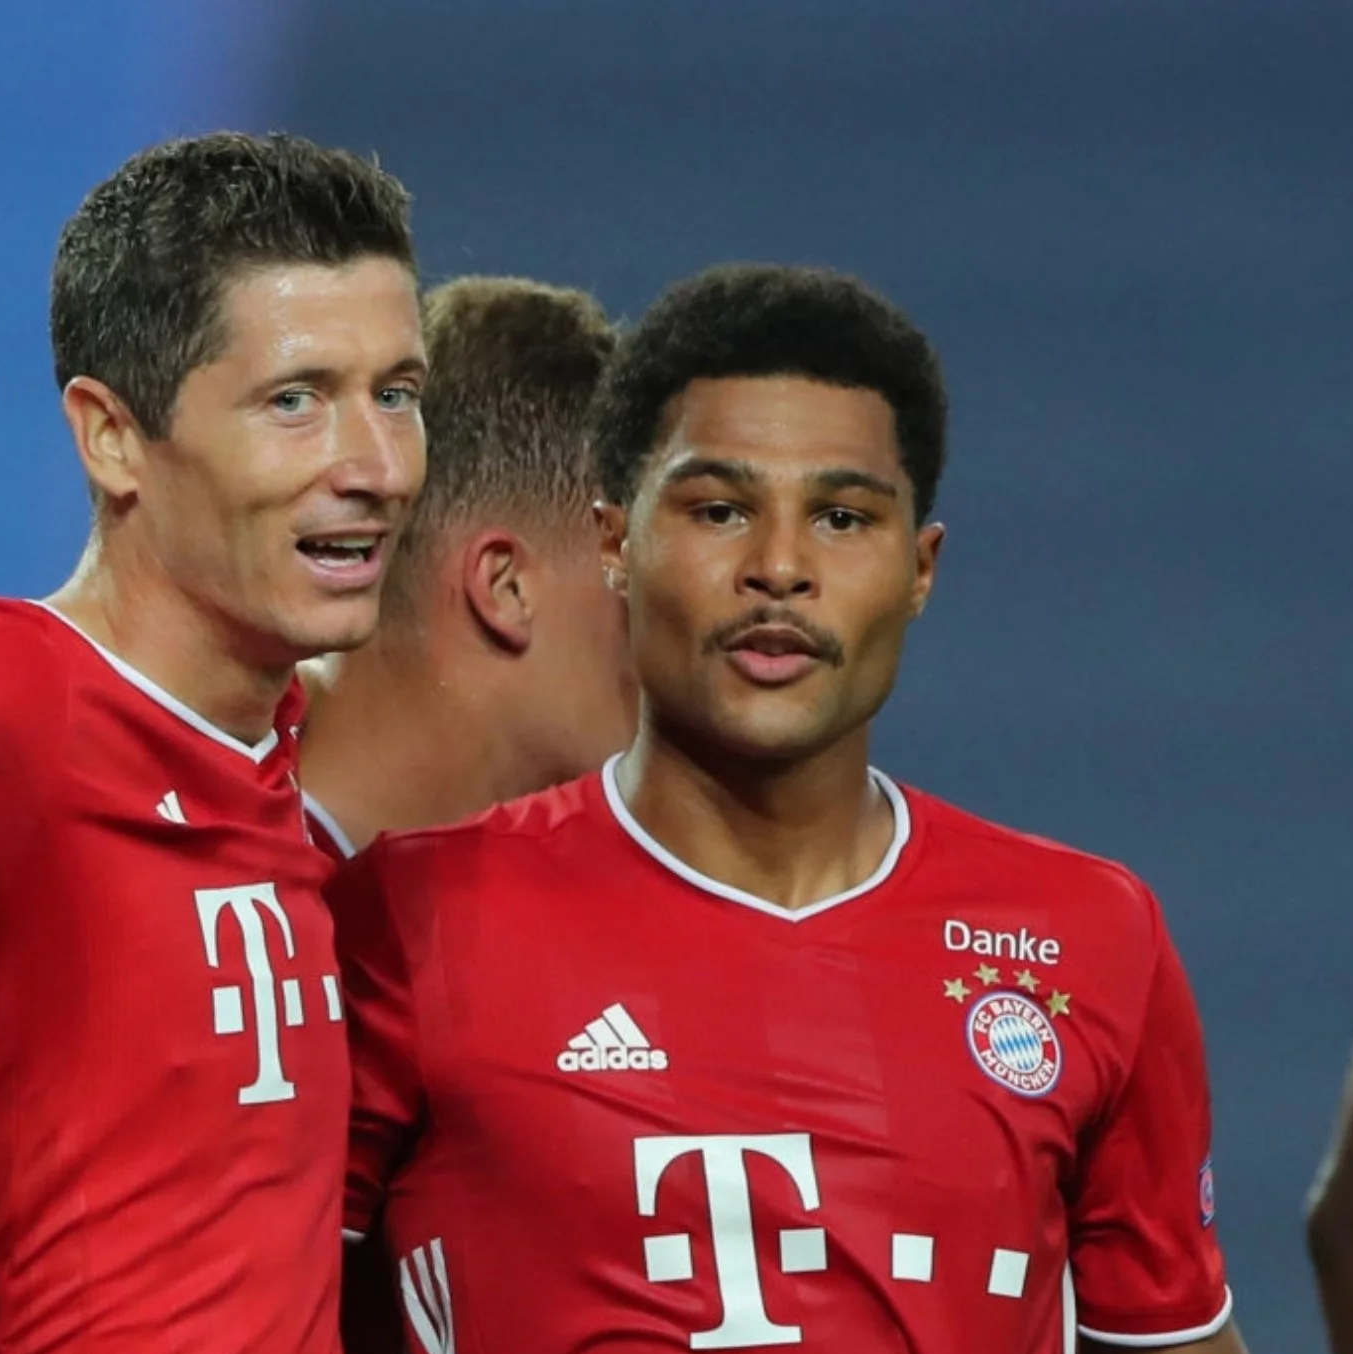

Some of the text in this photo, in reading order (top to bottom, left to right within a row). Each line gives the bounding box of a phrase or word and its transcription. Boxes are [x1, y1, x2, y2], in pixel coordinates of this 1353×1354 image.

[944, 919, 1061, 965] Danke
[195, 882, 295, 1104] T
[974, 999, 1052, 1042] FC BAYERN
[557, 1045, 668, 1073] adidas
[633, 1133, 821, 1349] T
